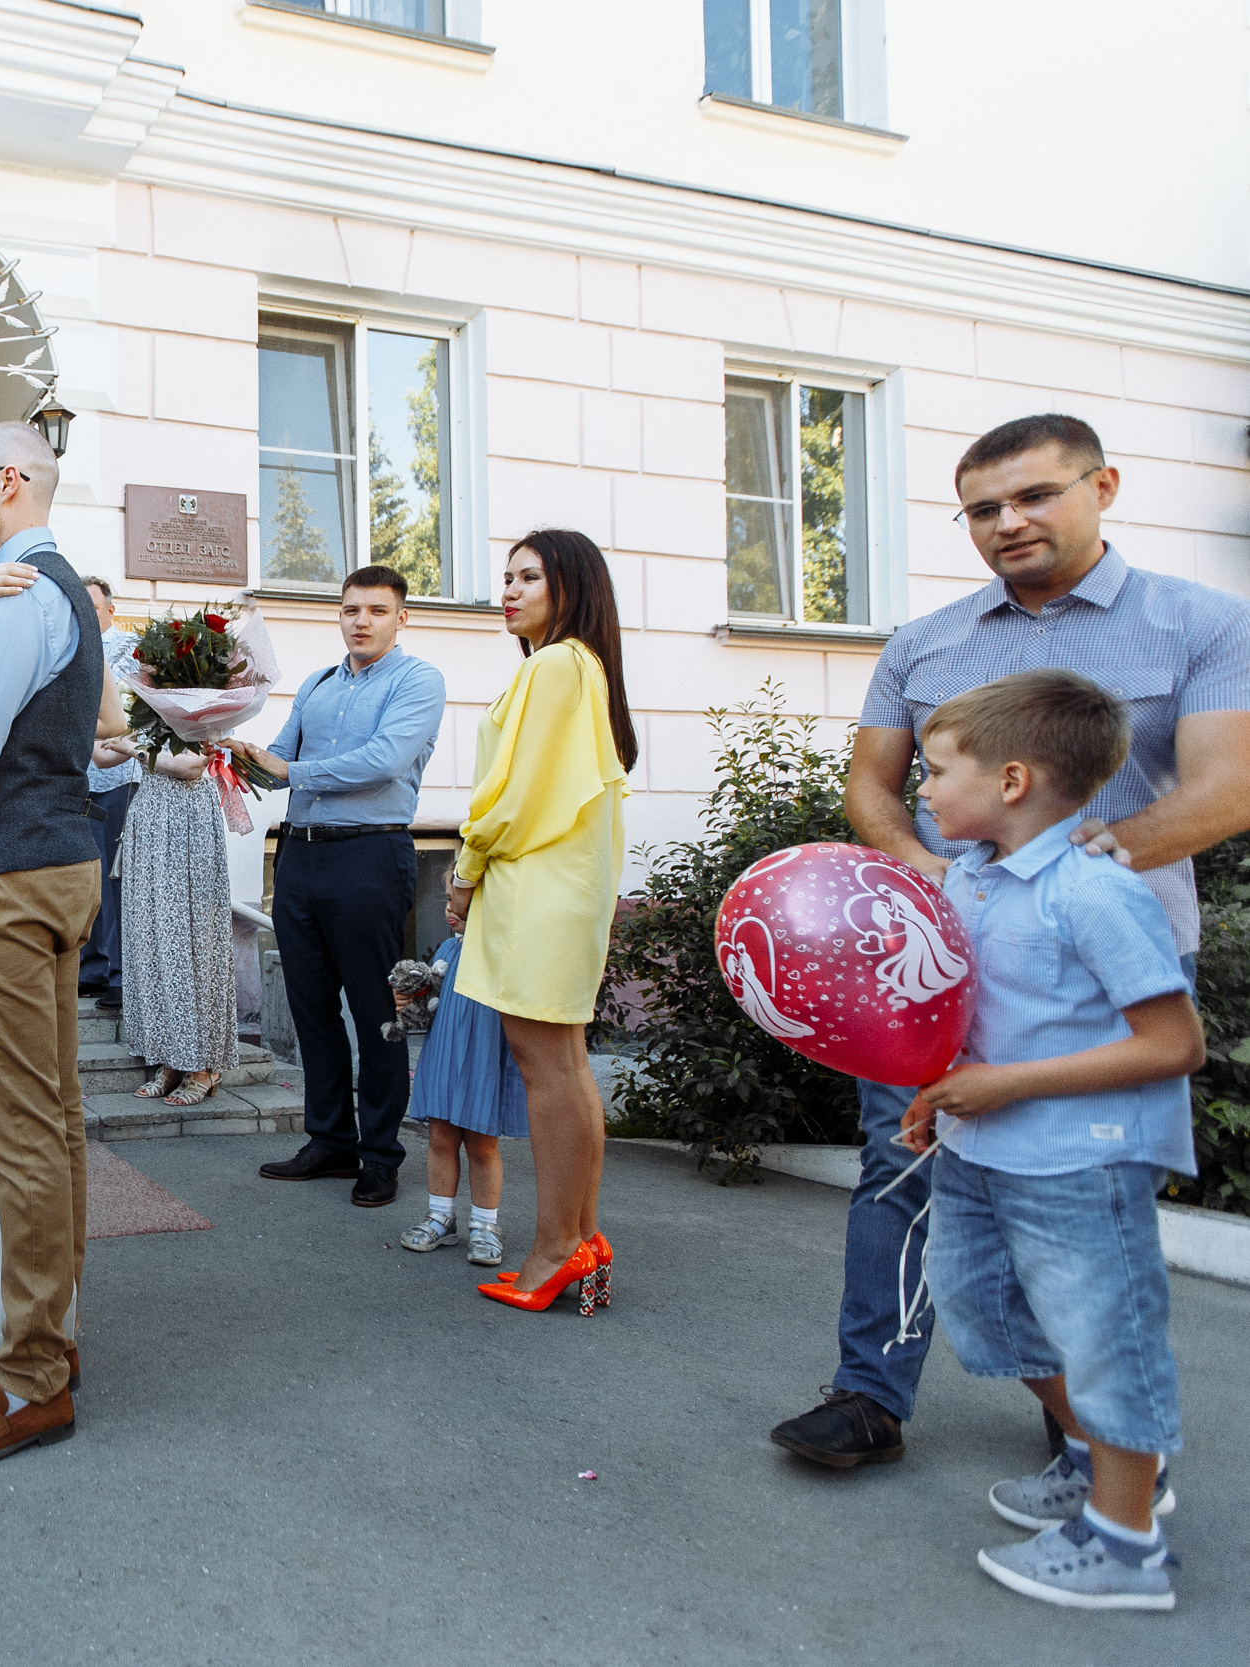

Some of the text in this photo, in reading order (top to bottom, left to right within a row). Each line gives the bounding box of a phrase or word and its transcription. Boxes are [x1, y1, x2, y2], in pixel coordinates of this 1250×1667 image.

[147, 540, 230, 557] ОТДЕЛ ЗАГС
[138, 554, 204, 565] ПЕРВОМАЙСКОГО
